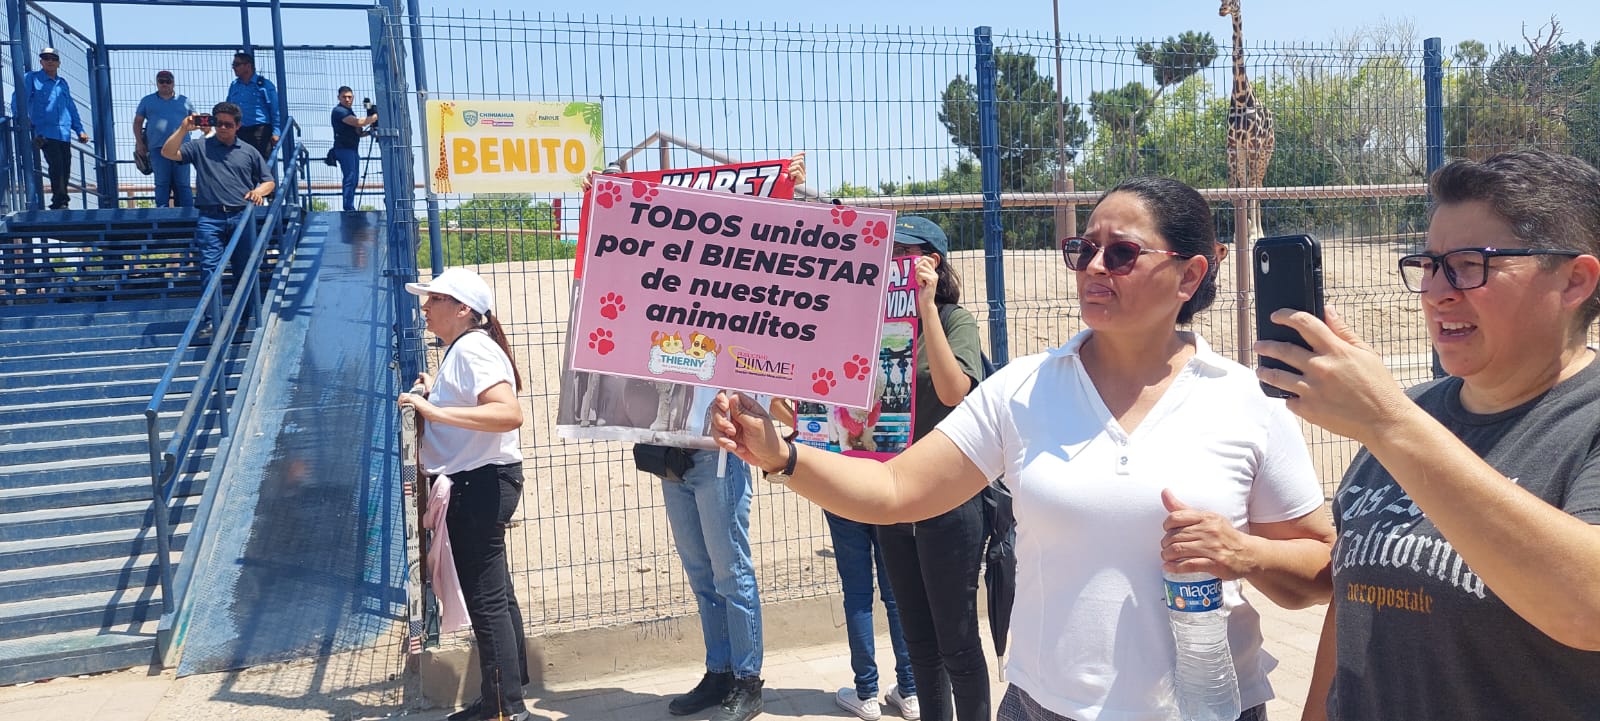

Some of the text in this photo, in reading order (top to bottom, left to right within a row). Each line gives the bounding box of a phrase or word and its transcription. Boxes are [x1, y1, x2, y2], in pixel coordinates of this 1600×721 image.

[453, 137, 586, 174] BENITO
[661, 164, 782, 198] AREZ
[629, 201, 858, 251] TODOS unidos
[594, 233, 880, 287] por el BIENESTAR
[640, 267, 831, 312] de nuestros
[887, 289, 917, 318] VIDA
[645, 302, 818, 342] animalitos
[660, 354, 705, 368] THIERNY
[1332, 520, 1486, 600] California
[1347, 582, 1433, 614] aeropostale
